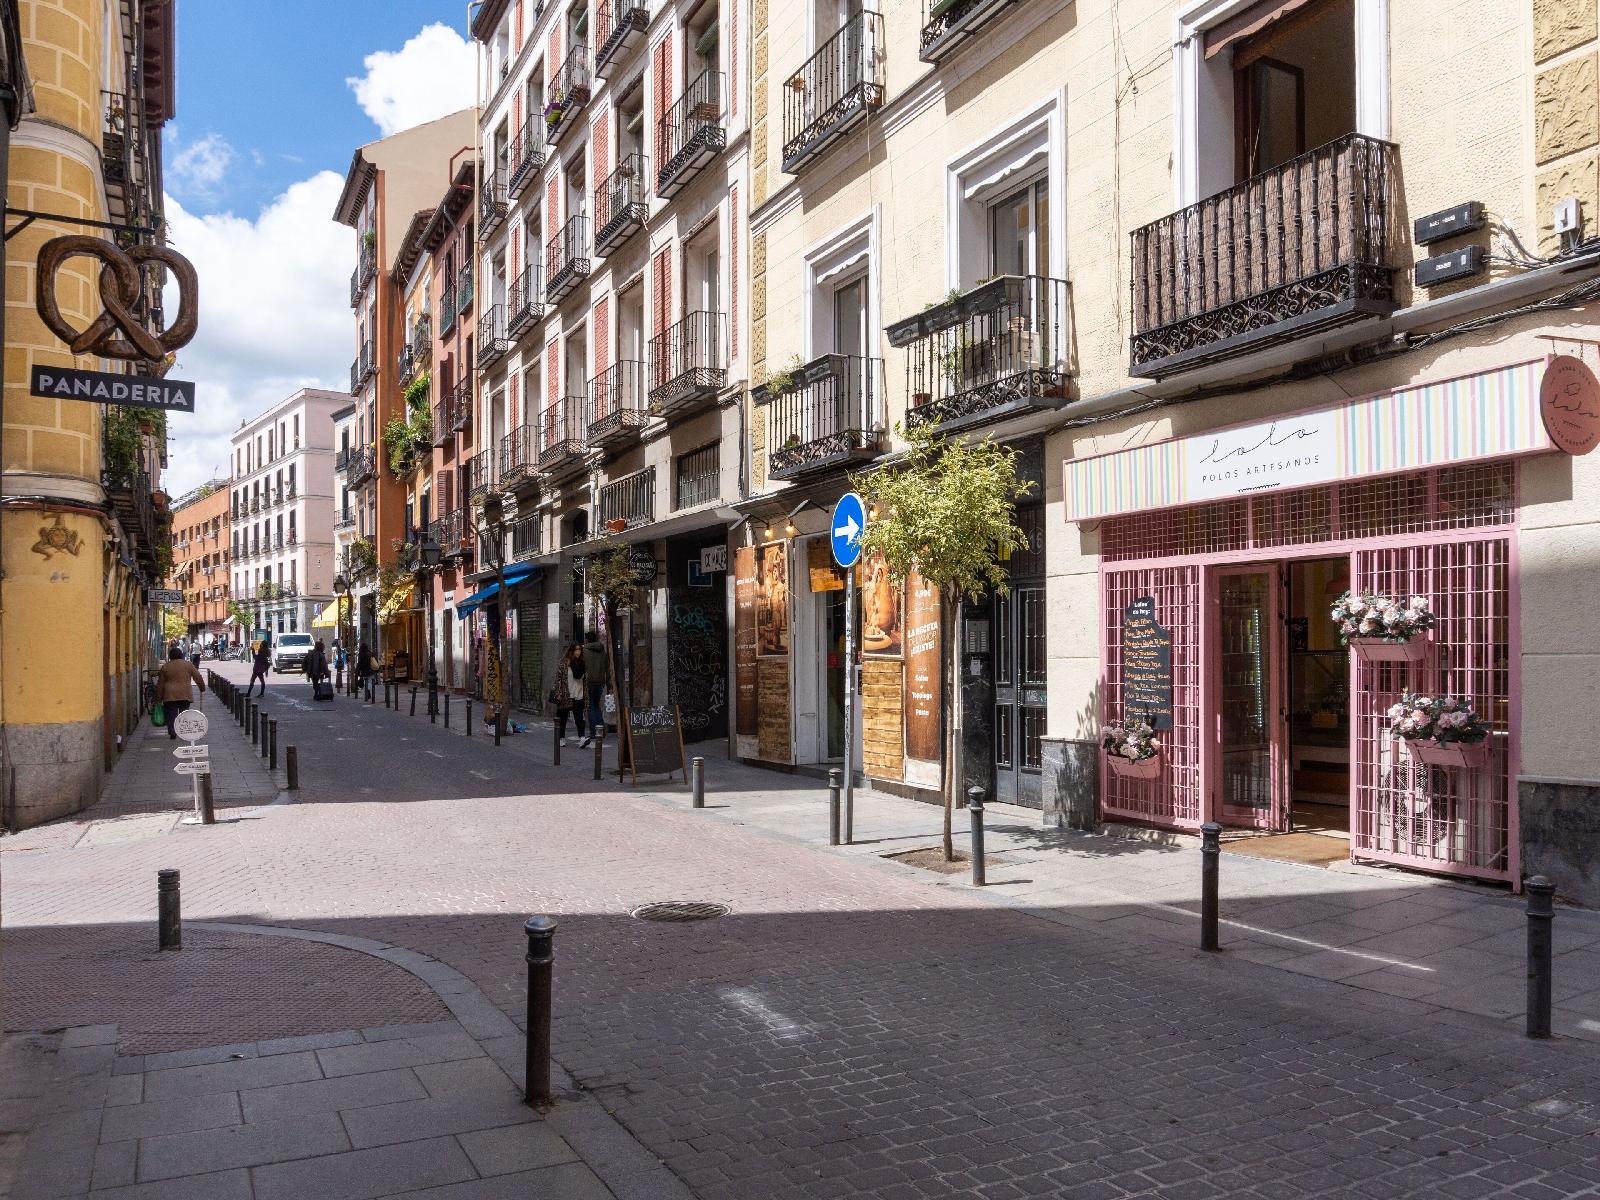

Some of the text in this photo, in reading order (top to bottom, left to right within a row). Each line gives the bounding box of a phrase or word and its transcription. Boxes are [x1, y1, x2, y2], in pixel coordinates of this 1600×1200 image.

[39, 374, 189, 406] PANADERIA
[1202, 454, 1320, 483] POLOS ARTESANOS
